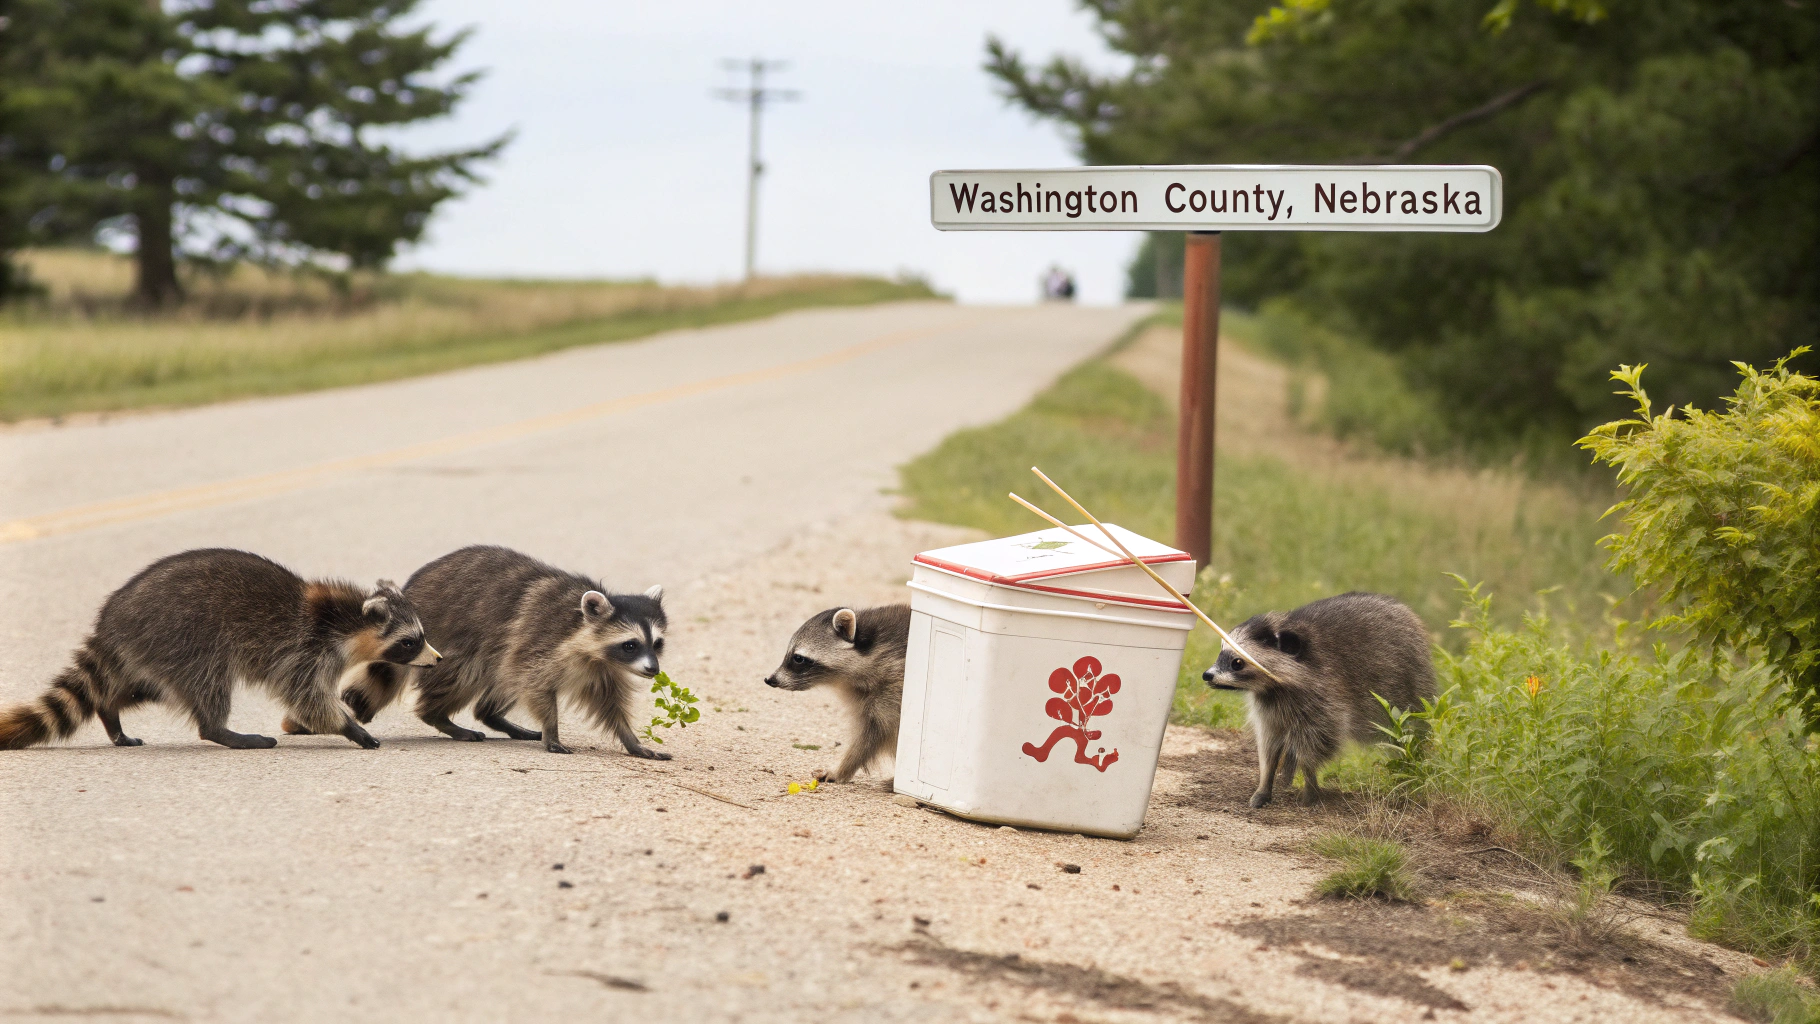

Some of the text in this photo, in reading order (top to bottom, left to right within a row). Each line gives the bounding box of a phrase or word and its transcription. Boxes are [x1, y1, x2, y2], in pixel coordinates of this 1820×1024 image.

[948, 181, 1483, 221] Washington County, Nebraska
